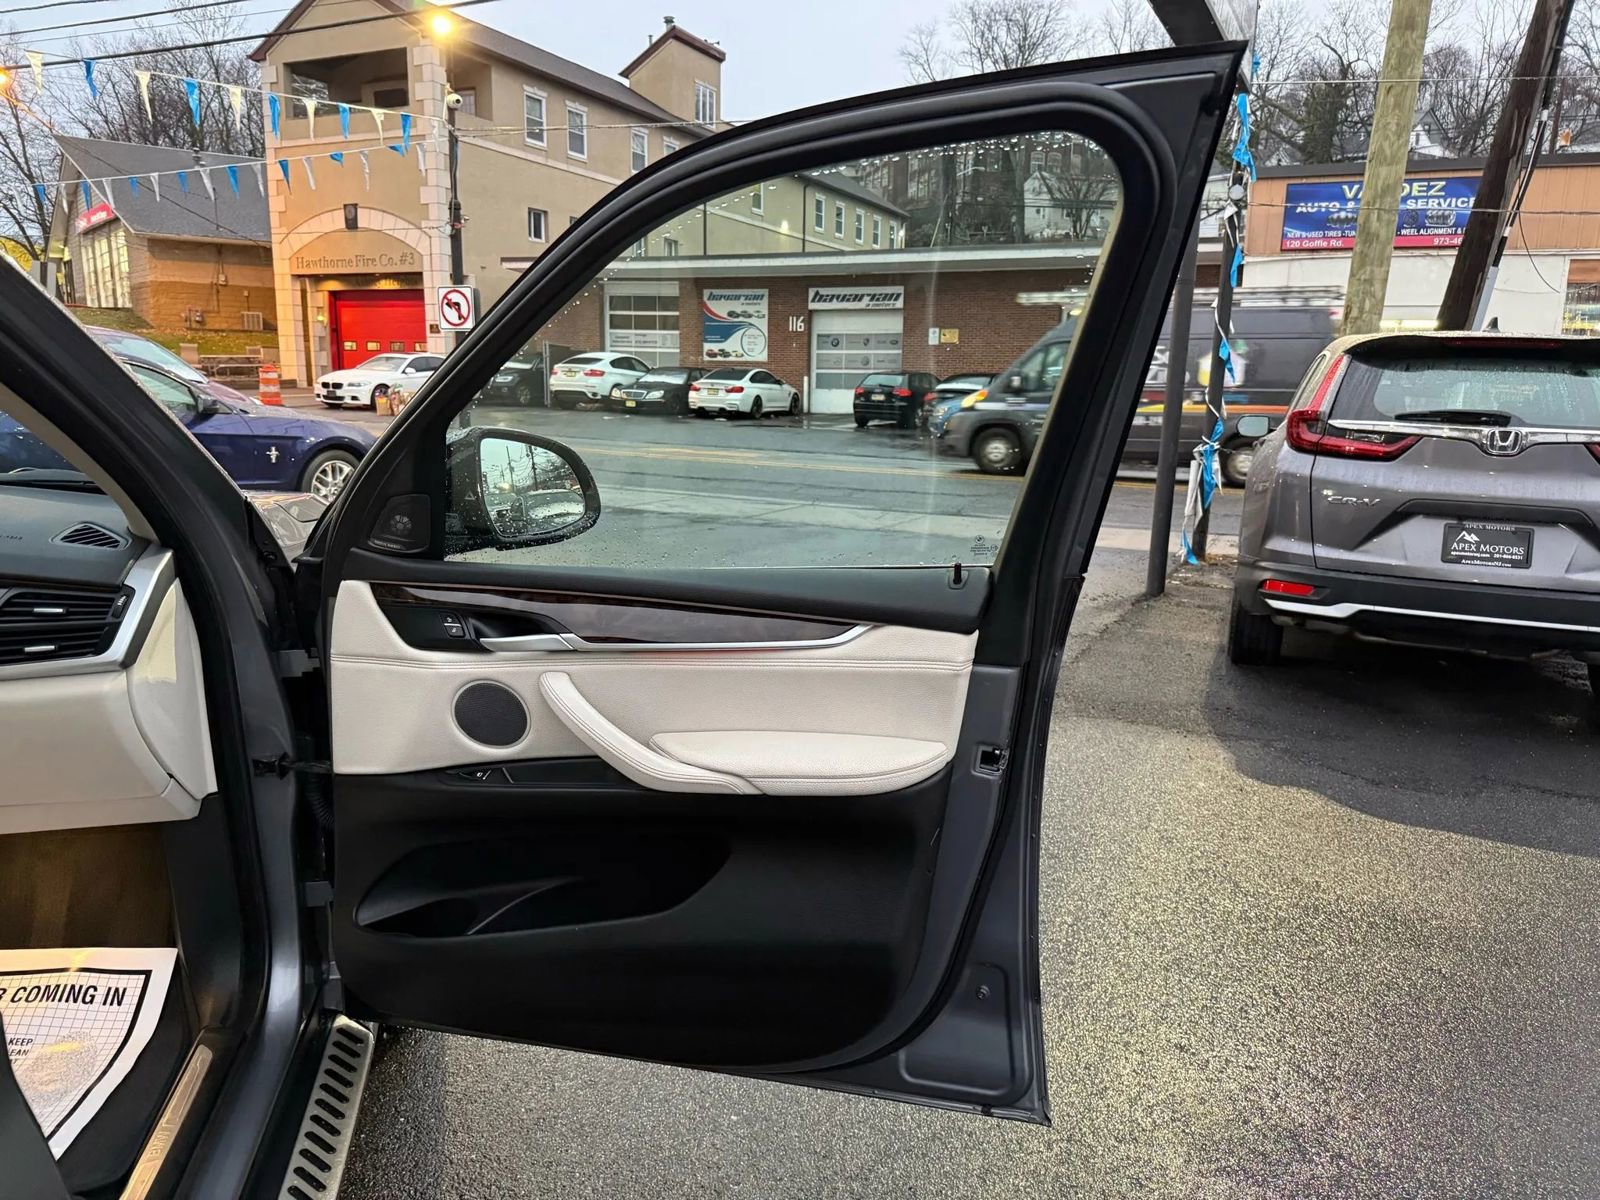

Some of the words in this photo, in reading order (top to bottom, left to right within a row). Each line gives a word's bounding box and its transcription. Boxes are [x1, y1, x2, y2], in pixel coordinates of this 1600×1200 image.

[1342, 181, 1446, 199] VDEZ
[1296, 202, 1340, 213] AUTO
[1347, 201, 1356, 211] &
[1286, 240, 1300, 248] 120
[1302, 240, 1328, 248] Goffle
[1330, 239, 1344, 247] Rd.
[296, 256, 354, 269] Hawthorne
[355, 254, 378, 268] Fire
[379, 253, 398, 268] Co.
[399, 252, 415, 266] #3
[789, 316, 805, 331] 116
[1327, 495, 1381, 506] CR-V
[1485, 524, 1516, 532] MOTORS
[1451, 542, 1477, 551] APEX
[1480, 544, 1525, 554] MOTORS
[10, 984, 98, 1005] COMING
[102, 987, 128, 1006] IN
[8, 1037, 33, 1046] KEEP
[10, 1049, 29, 1057] EAN
